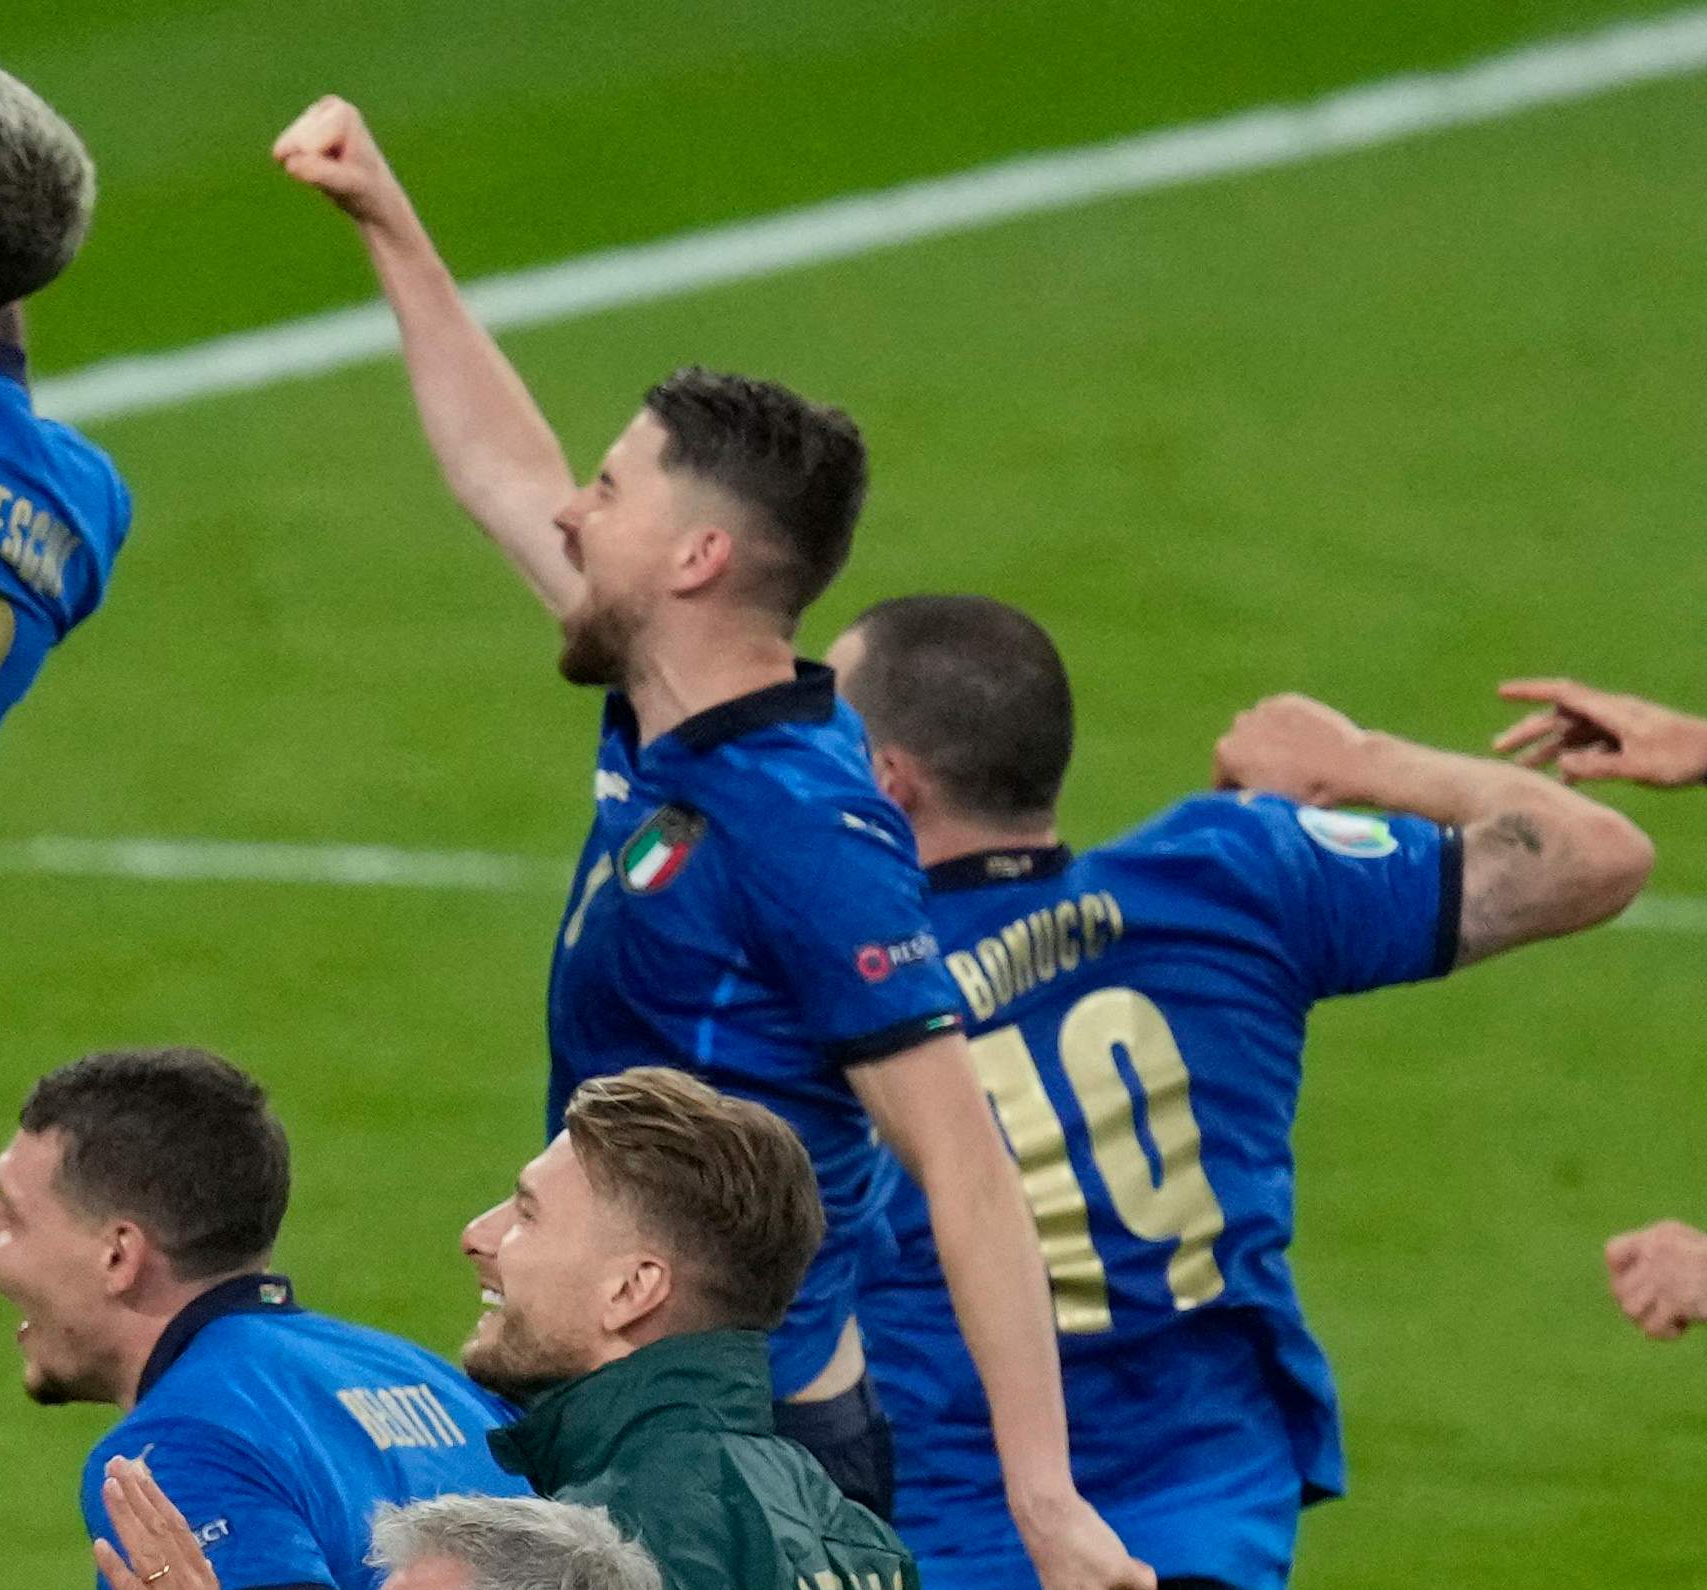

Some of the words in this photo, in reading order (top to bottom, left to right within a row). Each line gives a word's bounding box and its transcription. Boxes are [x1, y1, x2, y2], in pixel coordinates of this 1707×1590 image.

[944, 889, 1124, 1022] BONUCCI
[967, 985, 1226, 1335] 19
[335, 1383, 467, 1451] BELOTTI
